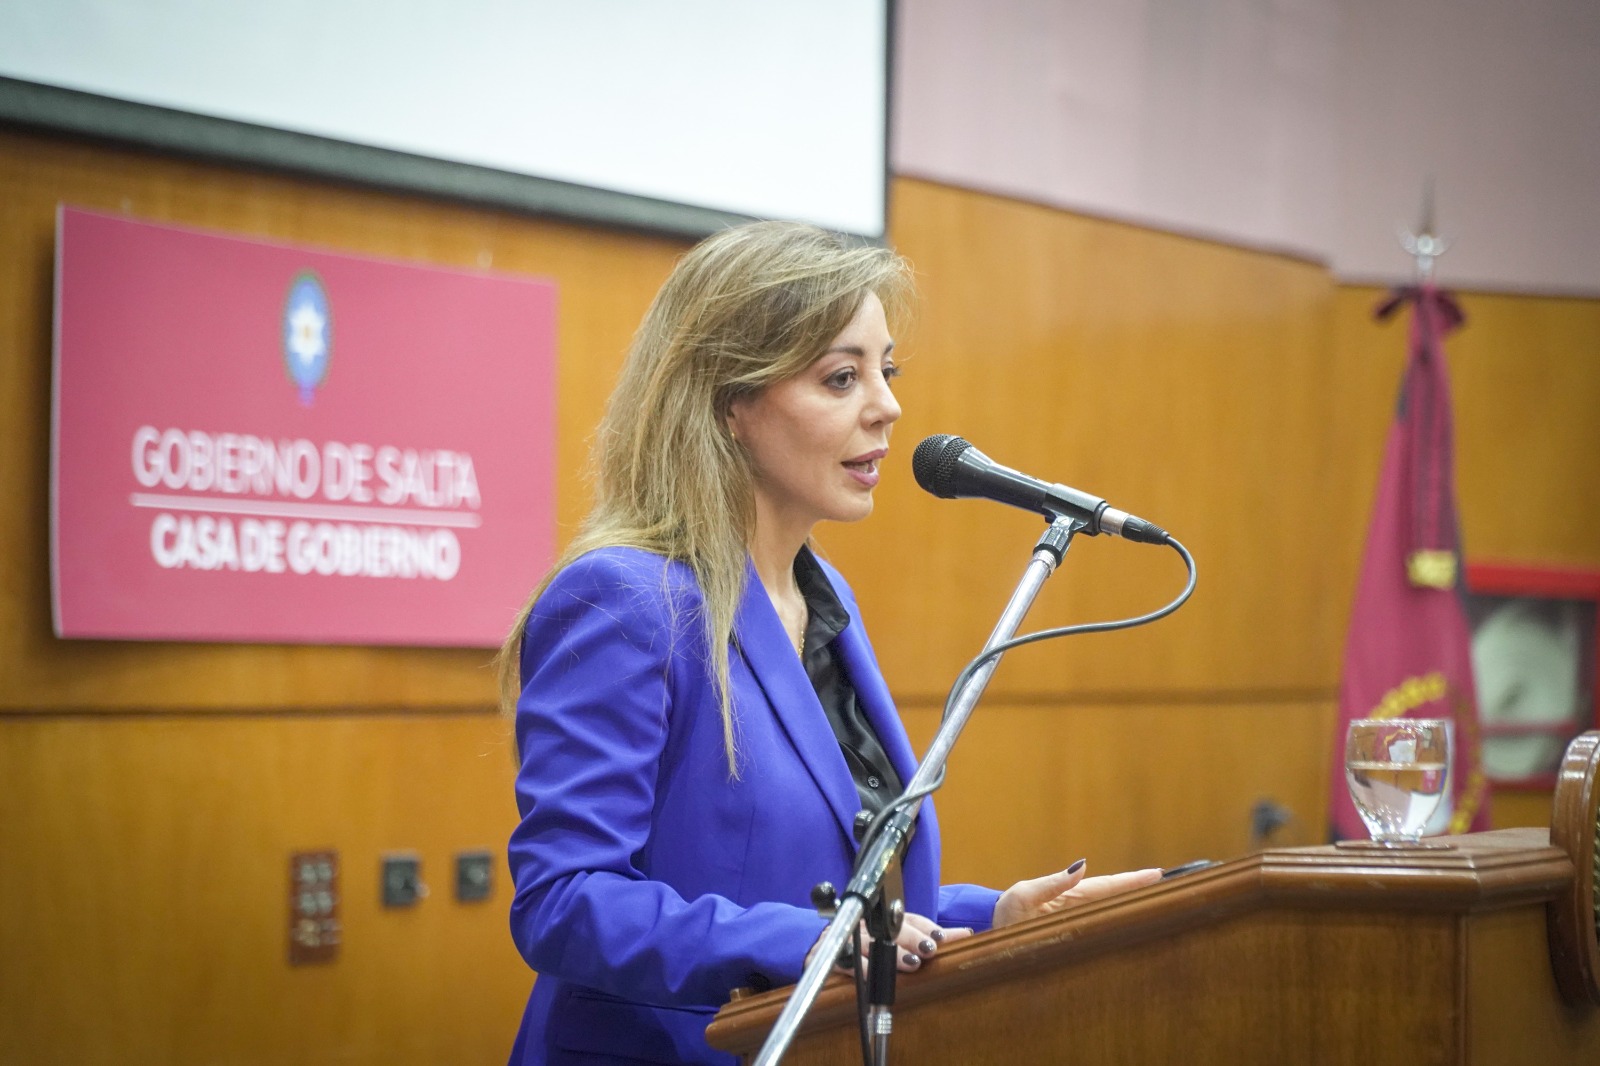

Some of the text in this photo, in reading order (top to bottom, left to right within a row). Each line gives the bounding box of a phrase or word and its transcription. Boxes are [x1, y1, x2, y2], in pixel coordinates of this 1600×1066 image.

[132, 426, 481, 509] GOBIERNO DE SALTA
[151, 513, 461, 580] CASA DE GOBIERNO
